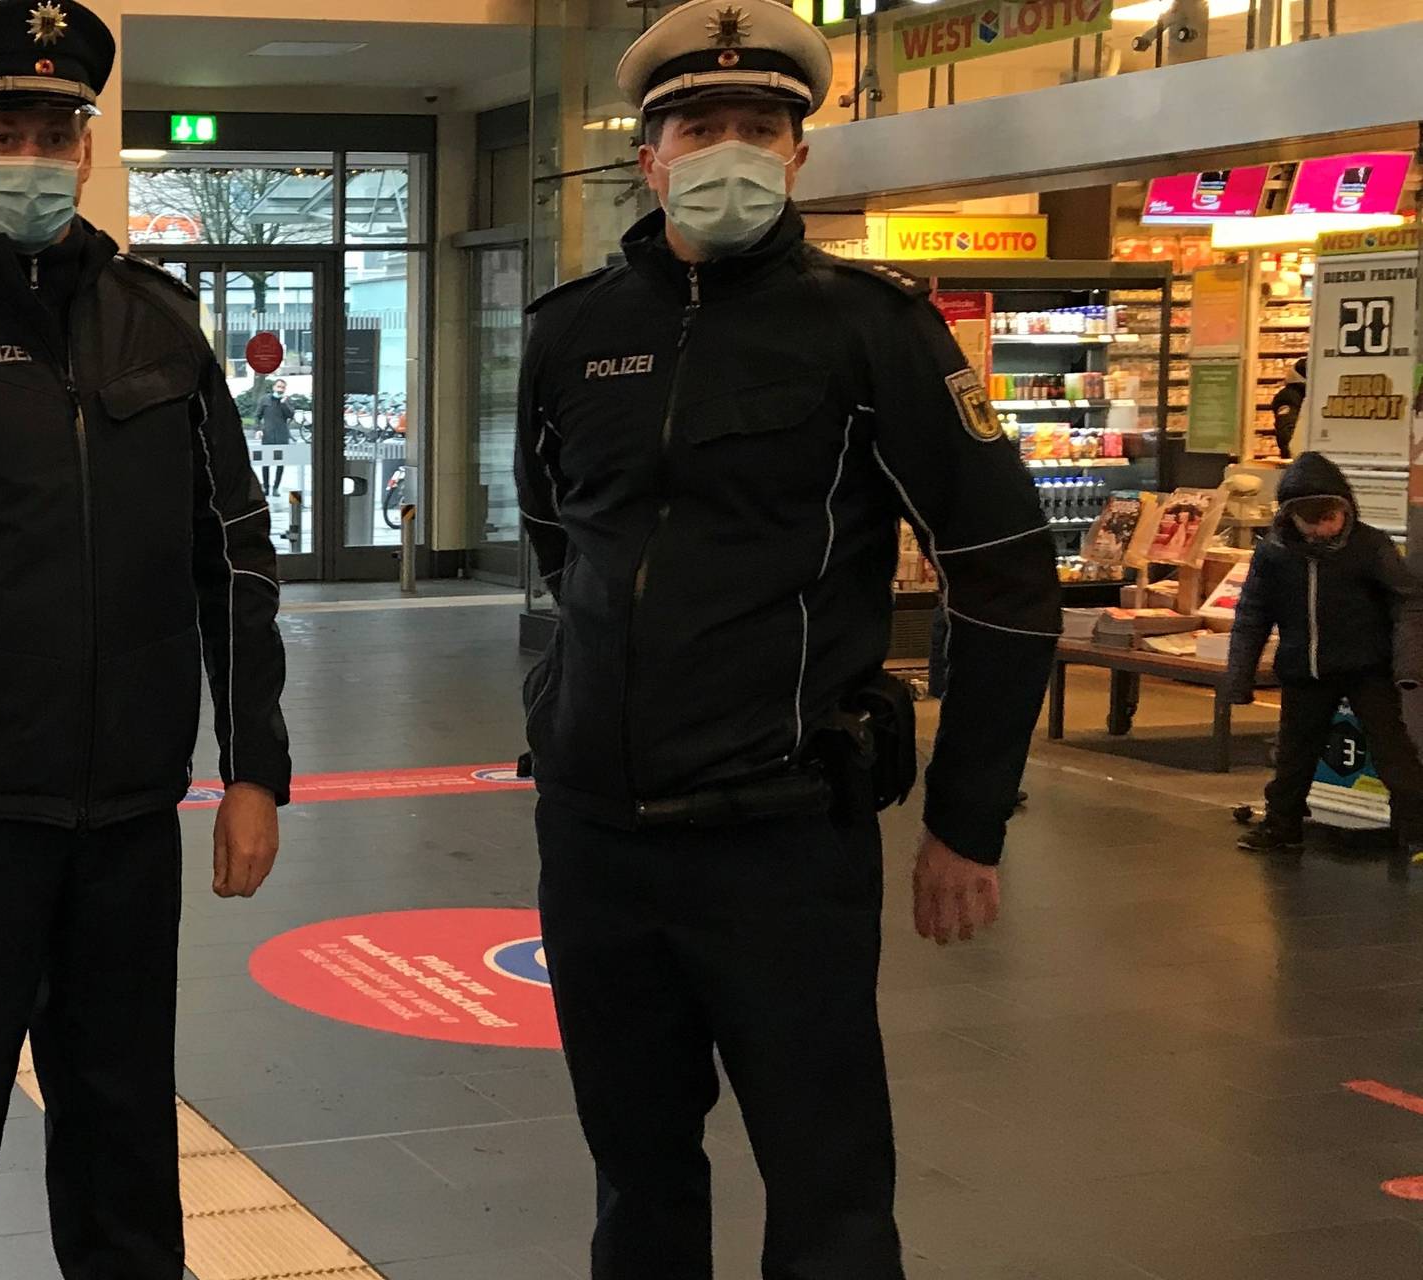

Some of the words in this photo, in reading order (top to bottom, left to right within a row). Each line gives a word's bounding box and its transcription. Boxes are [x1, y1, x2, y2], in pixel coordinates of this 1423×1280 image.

[902, 15, 976, 60] WEST
[1003, 0, 1101, 38] LOTTO
[899, 231, 954, 251] WEST
[973, 231, 1037, 252] LOTTO
[1322, 233, 1363, 251] WEST
[1340, 300, 1391, 355] 20
[585, 355, 654, 379] POLIZEI
[1338, 374, 1394, 396] EURO
[1321, 394, 1408, 420] JACKPOT
[413, 955, 472, 982] Pflicht
[458, 981, 496, 995] zur
